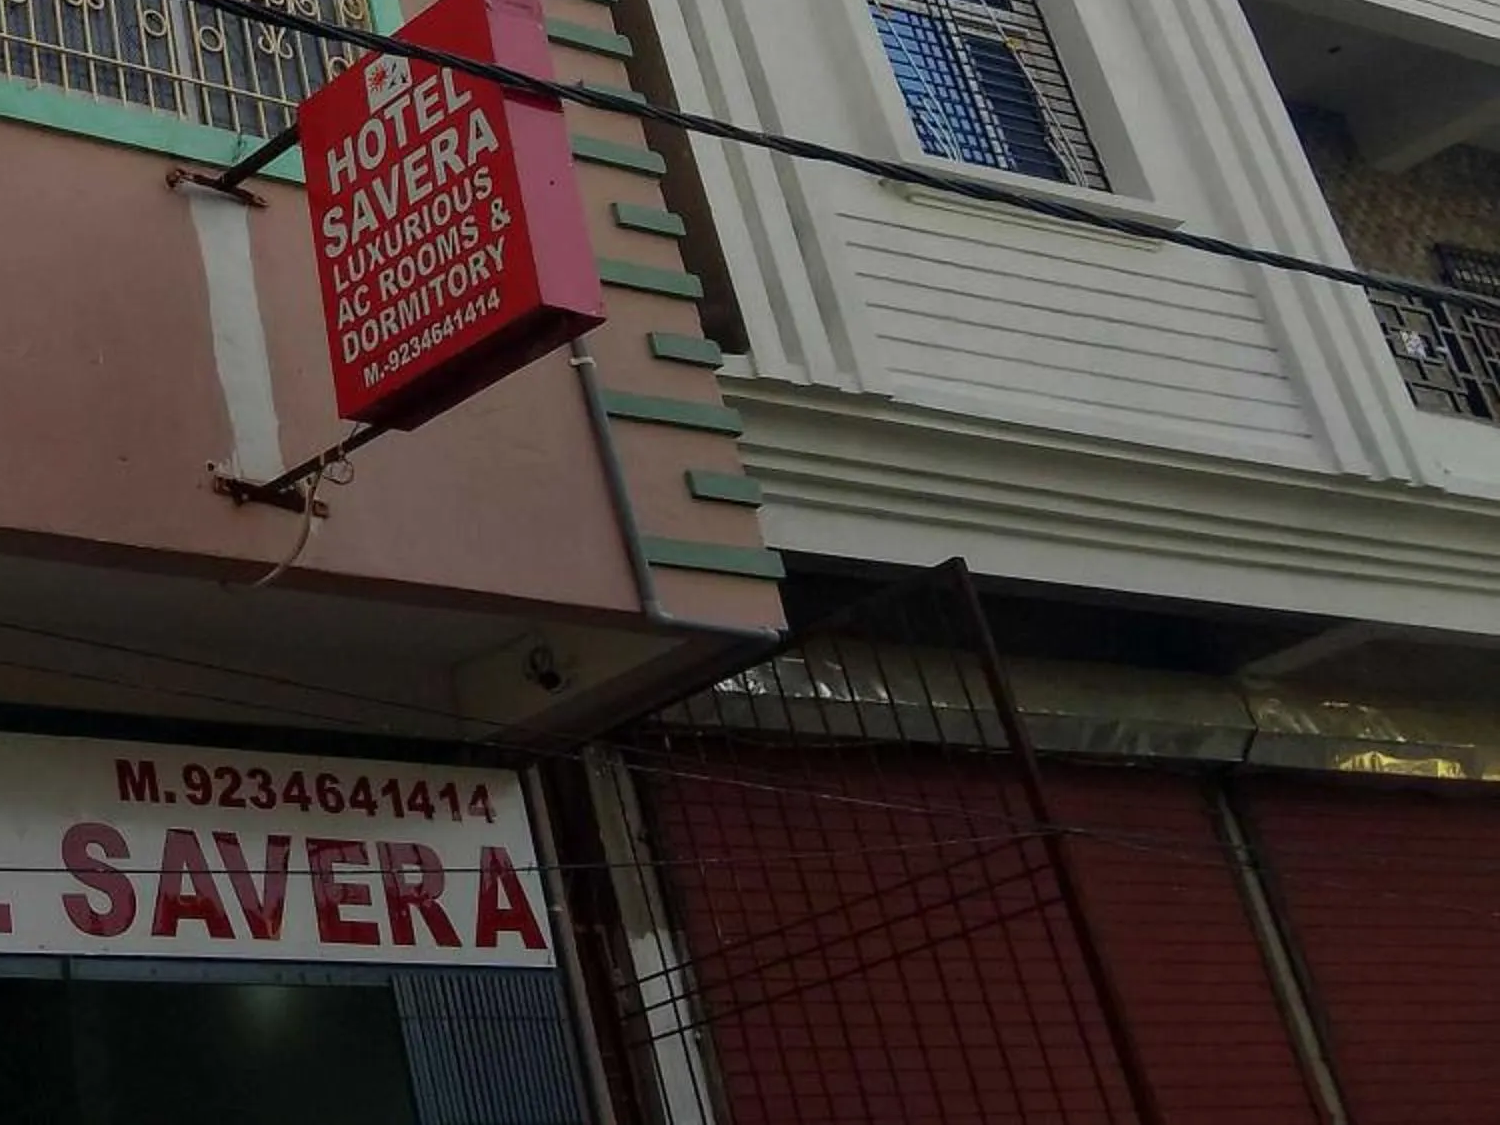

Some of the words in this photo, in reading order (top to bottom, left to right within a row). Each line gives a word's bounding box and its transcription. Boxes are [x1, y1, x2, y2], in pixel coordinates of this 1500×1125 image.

[322, 107, 499, 258] SAVERA
[326, 67, 472, 195] HOTEL
[334, 166, 493, 293] LUXURIOUS
[338, 285, 371, 329] AC
[378, 216, 479, 302] ROOMS
[490, 196, 511, 231] &
[342, 238, 506, 363] DORMITORY
[115, 758, 497, 824] M.9234641414
[60, 821, 549, 951] SAVERA
